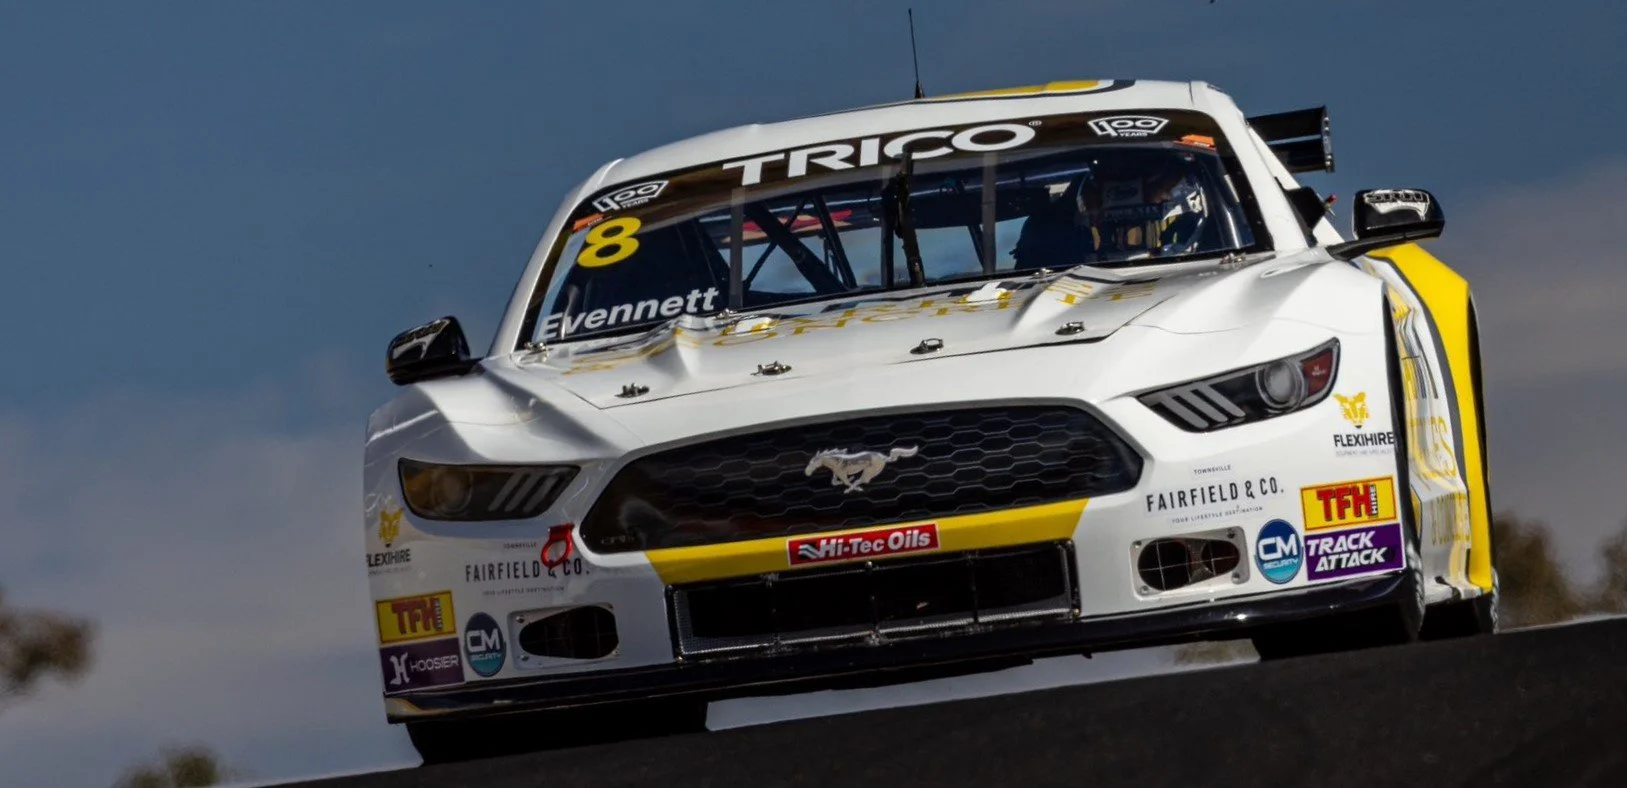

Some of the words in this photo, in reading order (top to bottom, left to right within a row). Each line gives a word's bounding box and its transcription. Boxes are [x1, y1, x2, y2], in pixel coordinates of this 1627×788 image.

[621, 196, 649, 209] YEARS
[577, 217, 642, 268] 8
[537, 286, 720, 341] Evennett
[1333, 431, 1395, 448] FLEXIHIRE
[1193, 464, 1232, 475] TOWNSVILLE
[1145, 482, 1239, 512] FAIRFIELD
[1244, 480, 1256, 500] &
[1259, 476, 1285, 496] CO.
[1316, 483, 1372, 522] TFH
[1190, 512, 1223, 523] LIFESTYLE
[818, 537, 885, 558] Hi-Tec
[887, 529, 931, 550] Oils
[1257, 533, 1299, 561] CM
[1306, 531, 1376, 557] TRACK
[465, 560, 541, 583] FAIRFIELD
[562, 557, 591, 576] CO.
[1262, 558, 1299, 570] SECURITY
[1314, 547, 1389, 573] ATTACK
[391, 597, 438, 635] TFH
[466, 628, 501, 653] CM
[409, 655, 460, 673] HOOSIER
